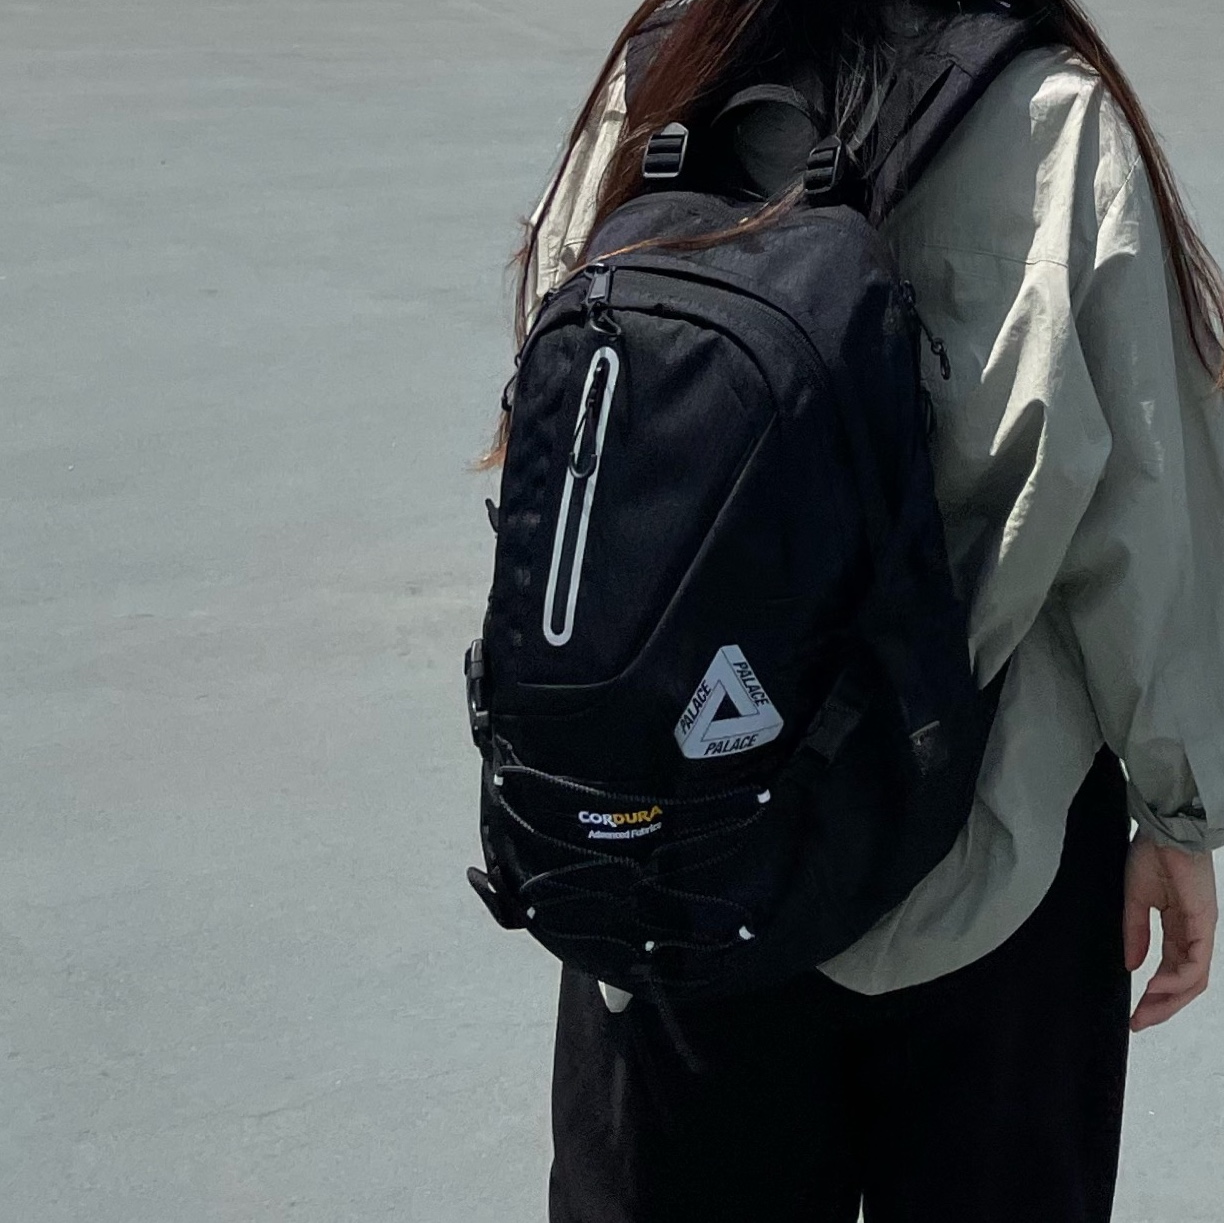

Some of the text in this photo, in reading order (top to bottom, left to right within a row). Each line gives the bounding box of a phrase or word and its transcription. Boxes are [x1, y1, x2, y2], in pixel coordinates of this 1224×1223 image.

[733, 661, 770, 707] PALACE
[680, 679, 712, 735] PALACE
[704, 733, 759, 756] PALACE
[578, 805, 663, 827] CORDURA
